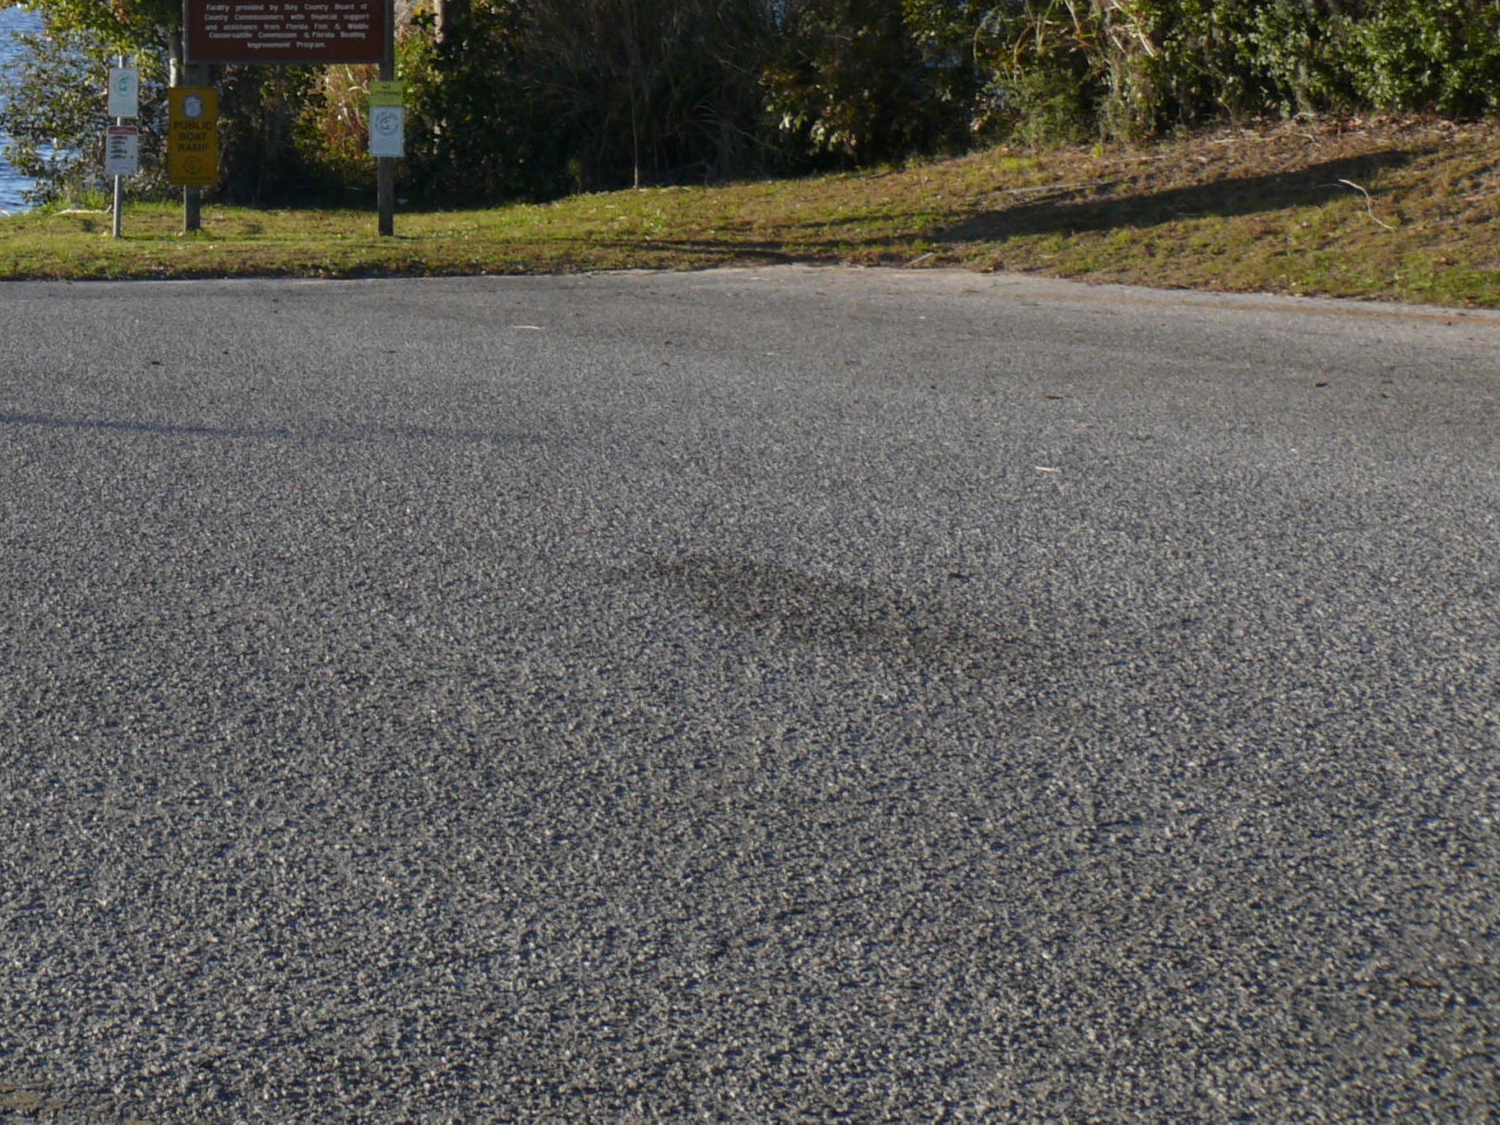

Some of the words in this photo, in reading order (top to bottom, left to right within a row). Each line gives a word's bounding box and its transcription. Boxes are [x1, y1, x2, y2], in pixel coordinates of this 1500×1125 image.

[235, 3, 264, 12] provided
[269, 4, 278, 12] by
[284, 3, 298, 12] Bay
[304, 3, 329, 12] County
[334, 3, 355, 11] Board
[360, 3, 368, 11] of
[204, 13, 228, 22] County
[234, 13, 284, 21] Commissioners
[343, 13, 370, 21] support
[286, 23, 309, 31] Florida
[314, 22, 329, 30] Fish
[312, 31, 335, 39] Florida
[173, 121, 212, 131] PUBLIC
[179, 131, 208, 142] BOAT
[177, 142, 208, 152] RAMP
